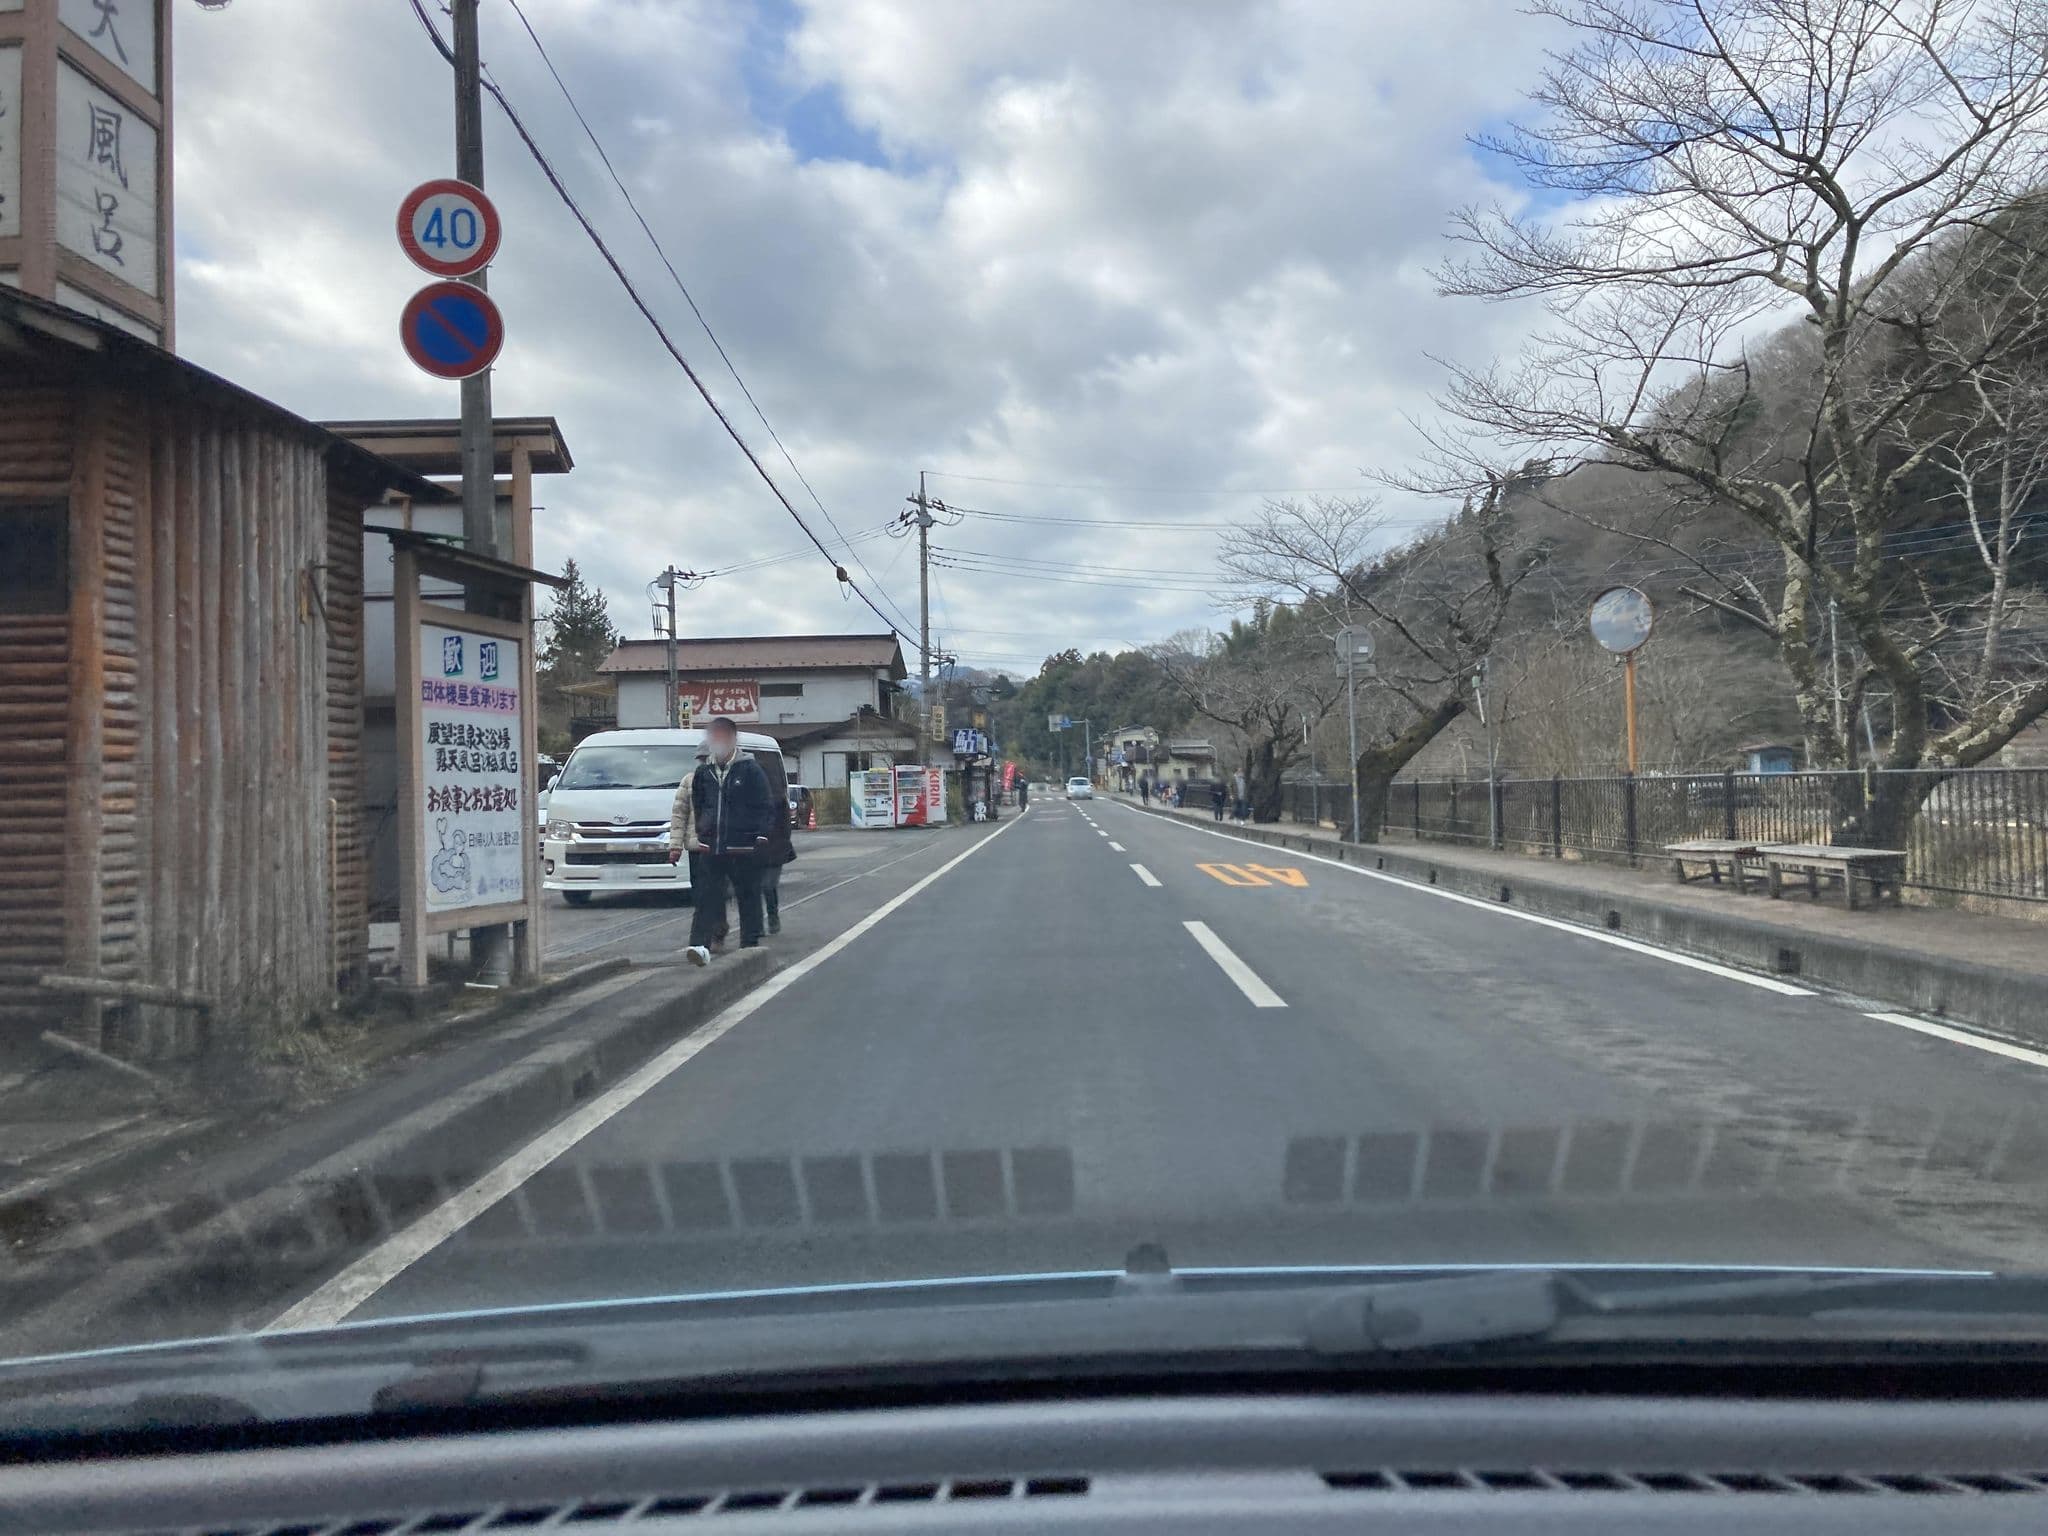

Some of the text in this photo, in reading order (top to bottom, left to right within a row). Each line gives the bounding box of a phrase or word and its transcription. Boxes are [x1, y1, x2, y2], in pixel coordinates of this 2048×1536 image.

[421, 207, 477, 249] 40
[427, 721, 512, 750] 展望温泉大浴場
[427, 783, 517, 815] お食事とお土産処
[929, 769, 940, 807] KIRIN
